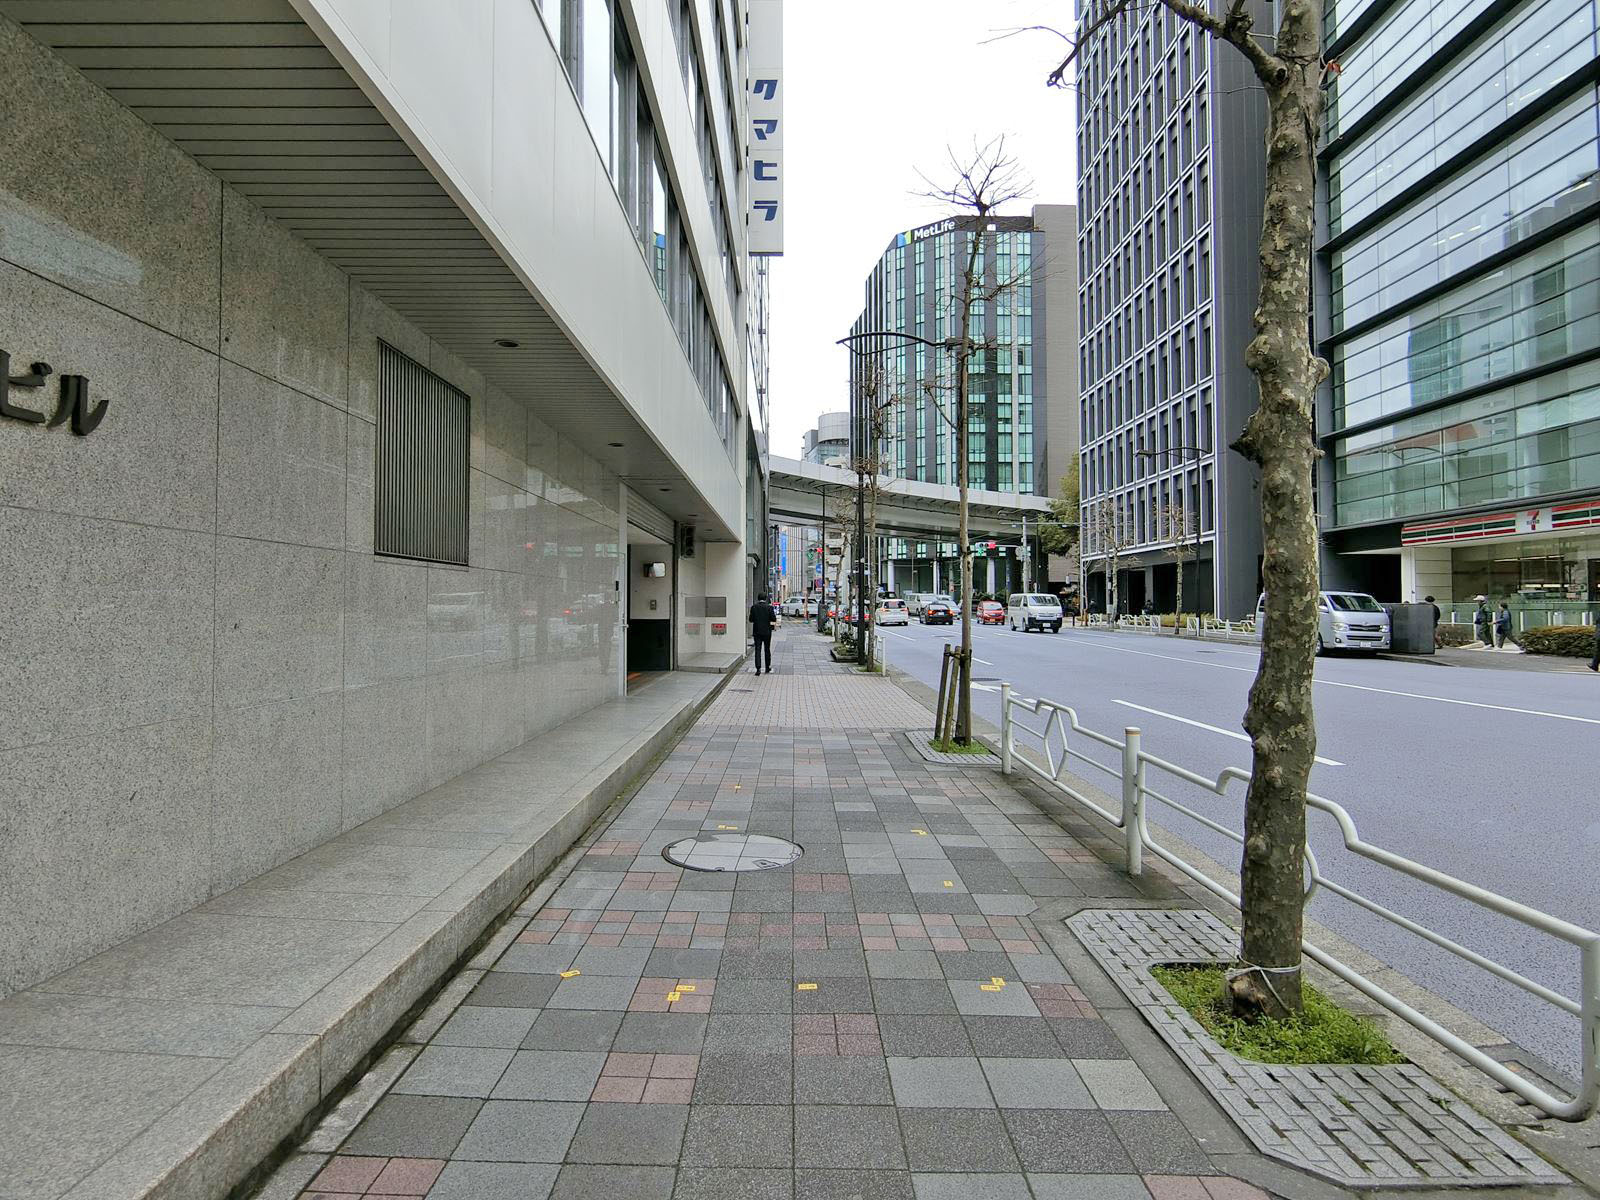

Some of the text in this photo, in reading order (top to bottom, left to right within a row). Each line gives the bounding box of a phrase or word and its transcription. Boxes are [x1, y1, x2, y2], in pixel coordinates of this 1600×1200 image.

[753, 79, 778, 222] クマヒラ
[914, 219, 956, 241] MetLife
[0, 349, 109, 436] ビル
